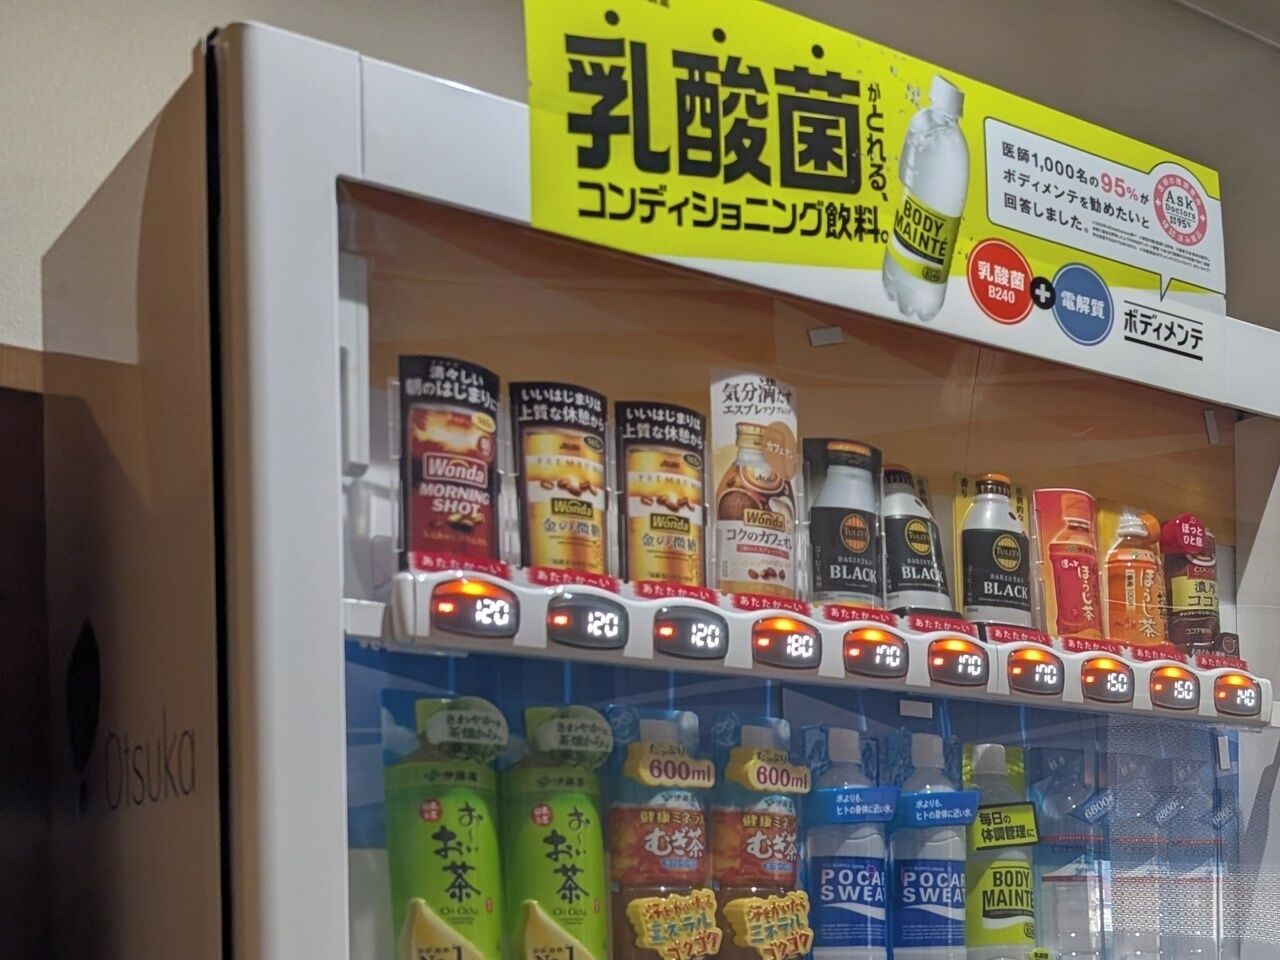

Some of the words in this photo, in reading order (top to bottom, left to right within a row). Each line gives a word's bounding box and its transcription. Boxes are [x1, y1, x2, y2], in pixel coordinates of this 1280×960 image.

[564, 33, 862, 194] 乳酸菌
[1166, 190, 1194, 211] Ask
[579, 181, 888, 244] コンディショニング飲料。
[903, 200, 944, 237] BODY
[1004, 193, 1089, 234] 回答しました。
[978, 261, 1025, 291] 乳酸菌
[988, 288, 1015, 303] B240
[1060, 290, 1105, 319] 電解質
[1124, 309, 1203, 349] ボディメンテ
[428, 457, 484, 483] Wonda
[419, 483, 489, 504] MORNING
[432, 499, 480, 514] SHOT
[652, 517, 689, 531] Wonda
[746, 513, 784, 529] Wonda
[1182, 523, 1202, 536] ほっと
[830, 565, 877, 584] BLACK
[902, 566, 944, 582] BLACK
[984, 582, 1028, 599] BLACK
[1078, 566, 1095, 620] ほうじ茶
[474, 598, 510, 626] 120
[587, 611, 619, 638] 120
[690, 623, 720, 648] 120
[786, 634, 814, 658] 180
[1107, 672, 1127, 693] 150
[1174, 680, 1193, 700] 150
[1236, 688, 1255, 707] 140
[650, 759, 711, 782] 600ml
[756, 765, 808, 788] 600ml
[980, 813, 1011, 825] 毎日の
[645, 826, 704, 858] むぎ茶
[981, 826, 1035, 842] 体調管理に
[431, 825, 481, 903] お茶
[543, 829, 589, 904] お茶
[993, 870, 1030, 887] BODY
